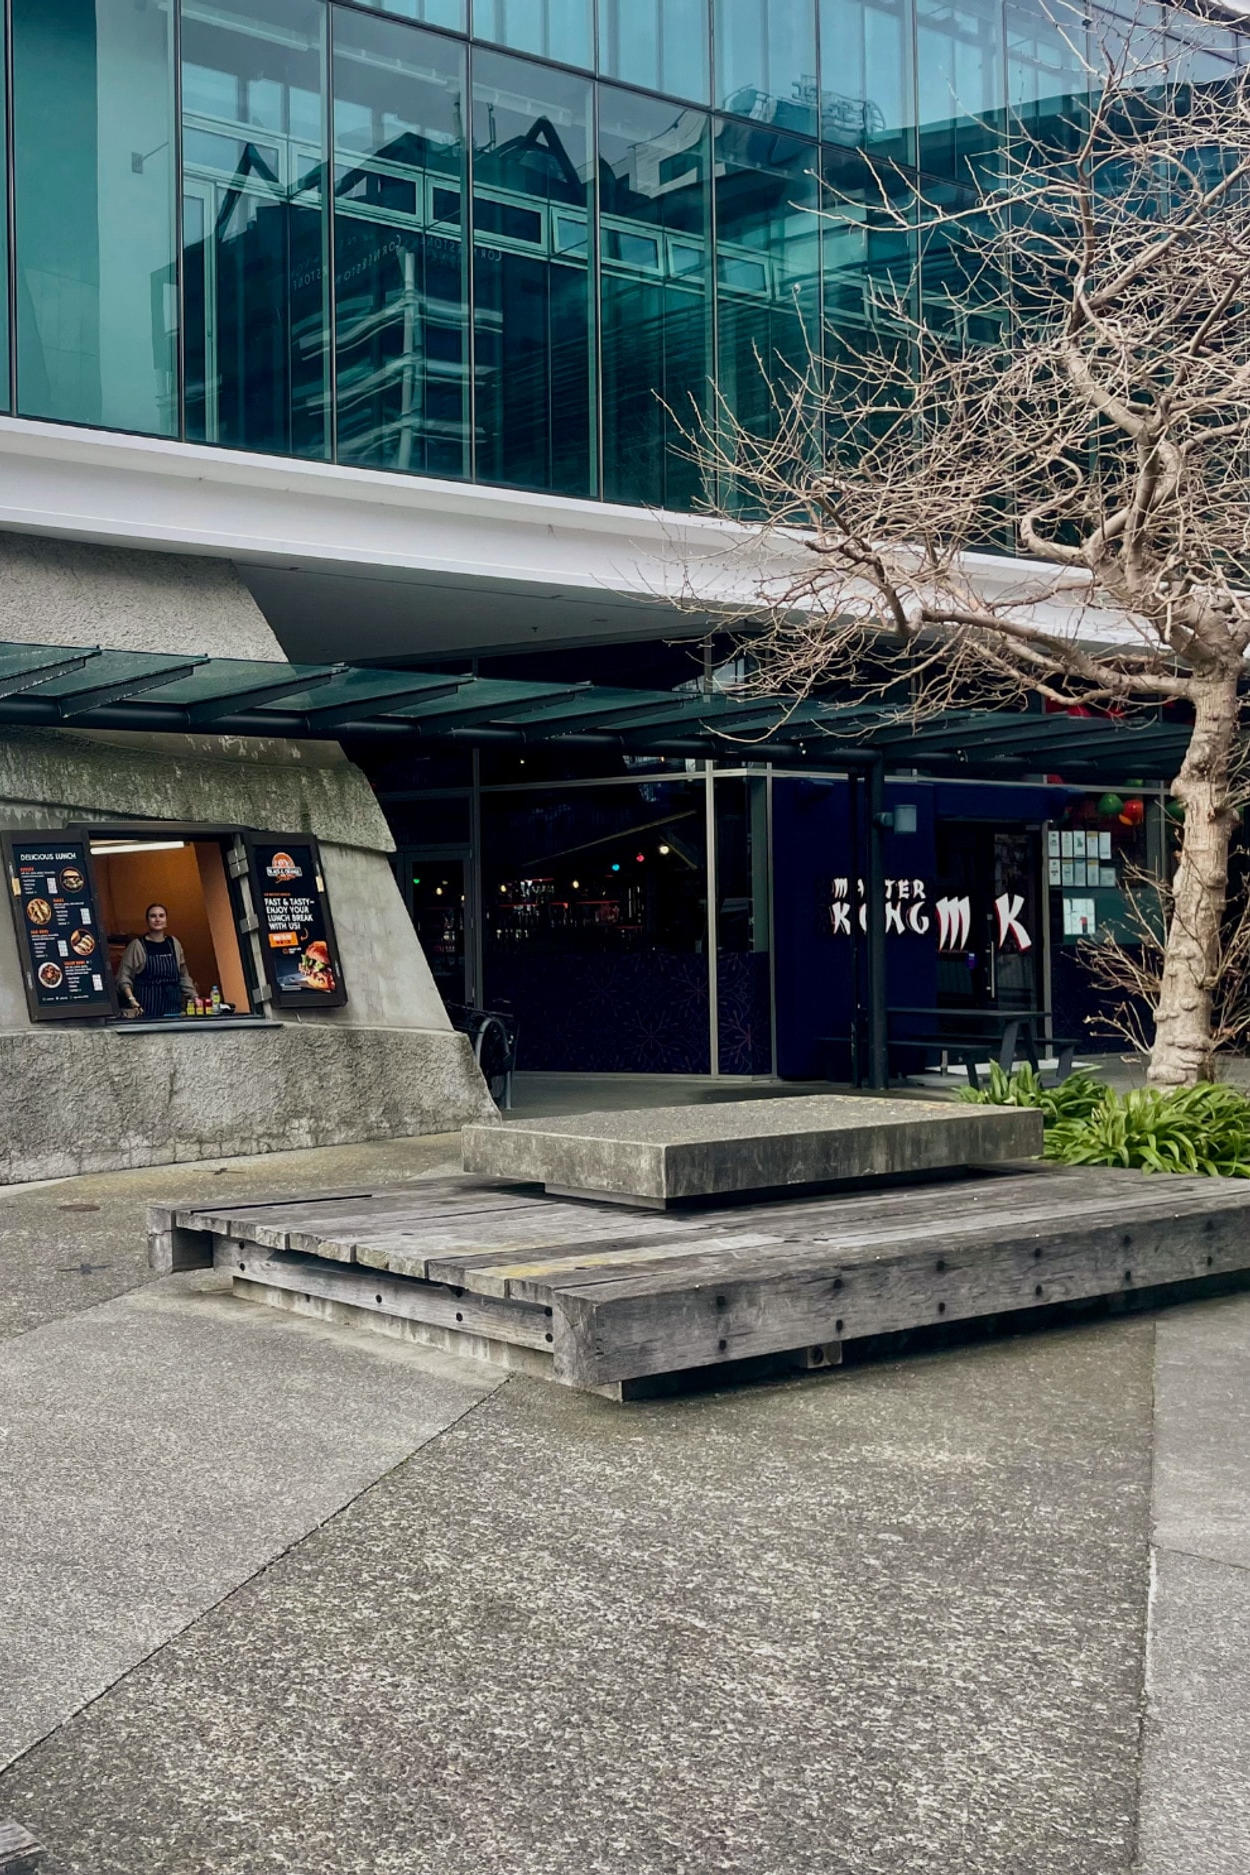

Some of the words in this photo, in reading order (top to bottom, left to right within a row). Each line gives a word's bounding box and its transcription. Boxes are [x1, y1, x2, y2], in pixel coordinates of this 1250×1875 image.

[20, 853, 54, 861] DELICIOUS
[55, 852, 77, 860] LUNCH
[832, 877, 926, 899] MTER
[263, 897, 281, 906] FAST
[283, 897, 289, 906] &
[266, 906, 288, 914] ENJOY
[289, 906, 310, 914] YOUR
[268, 914, 291, 922] LUNCH
[291, 914, 314, 922] BREAK
[995, 893, 1032, 950] K
[268, 922, 288, 930] WITH
